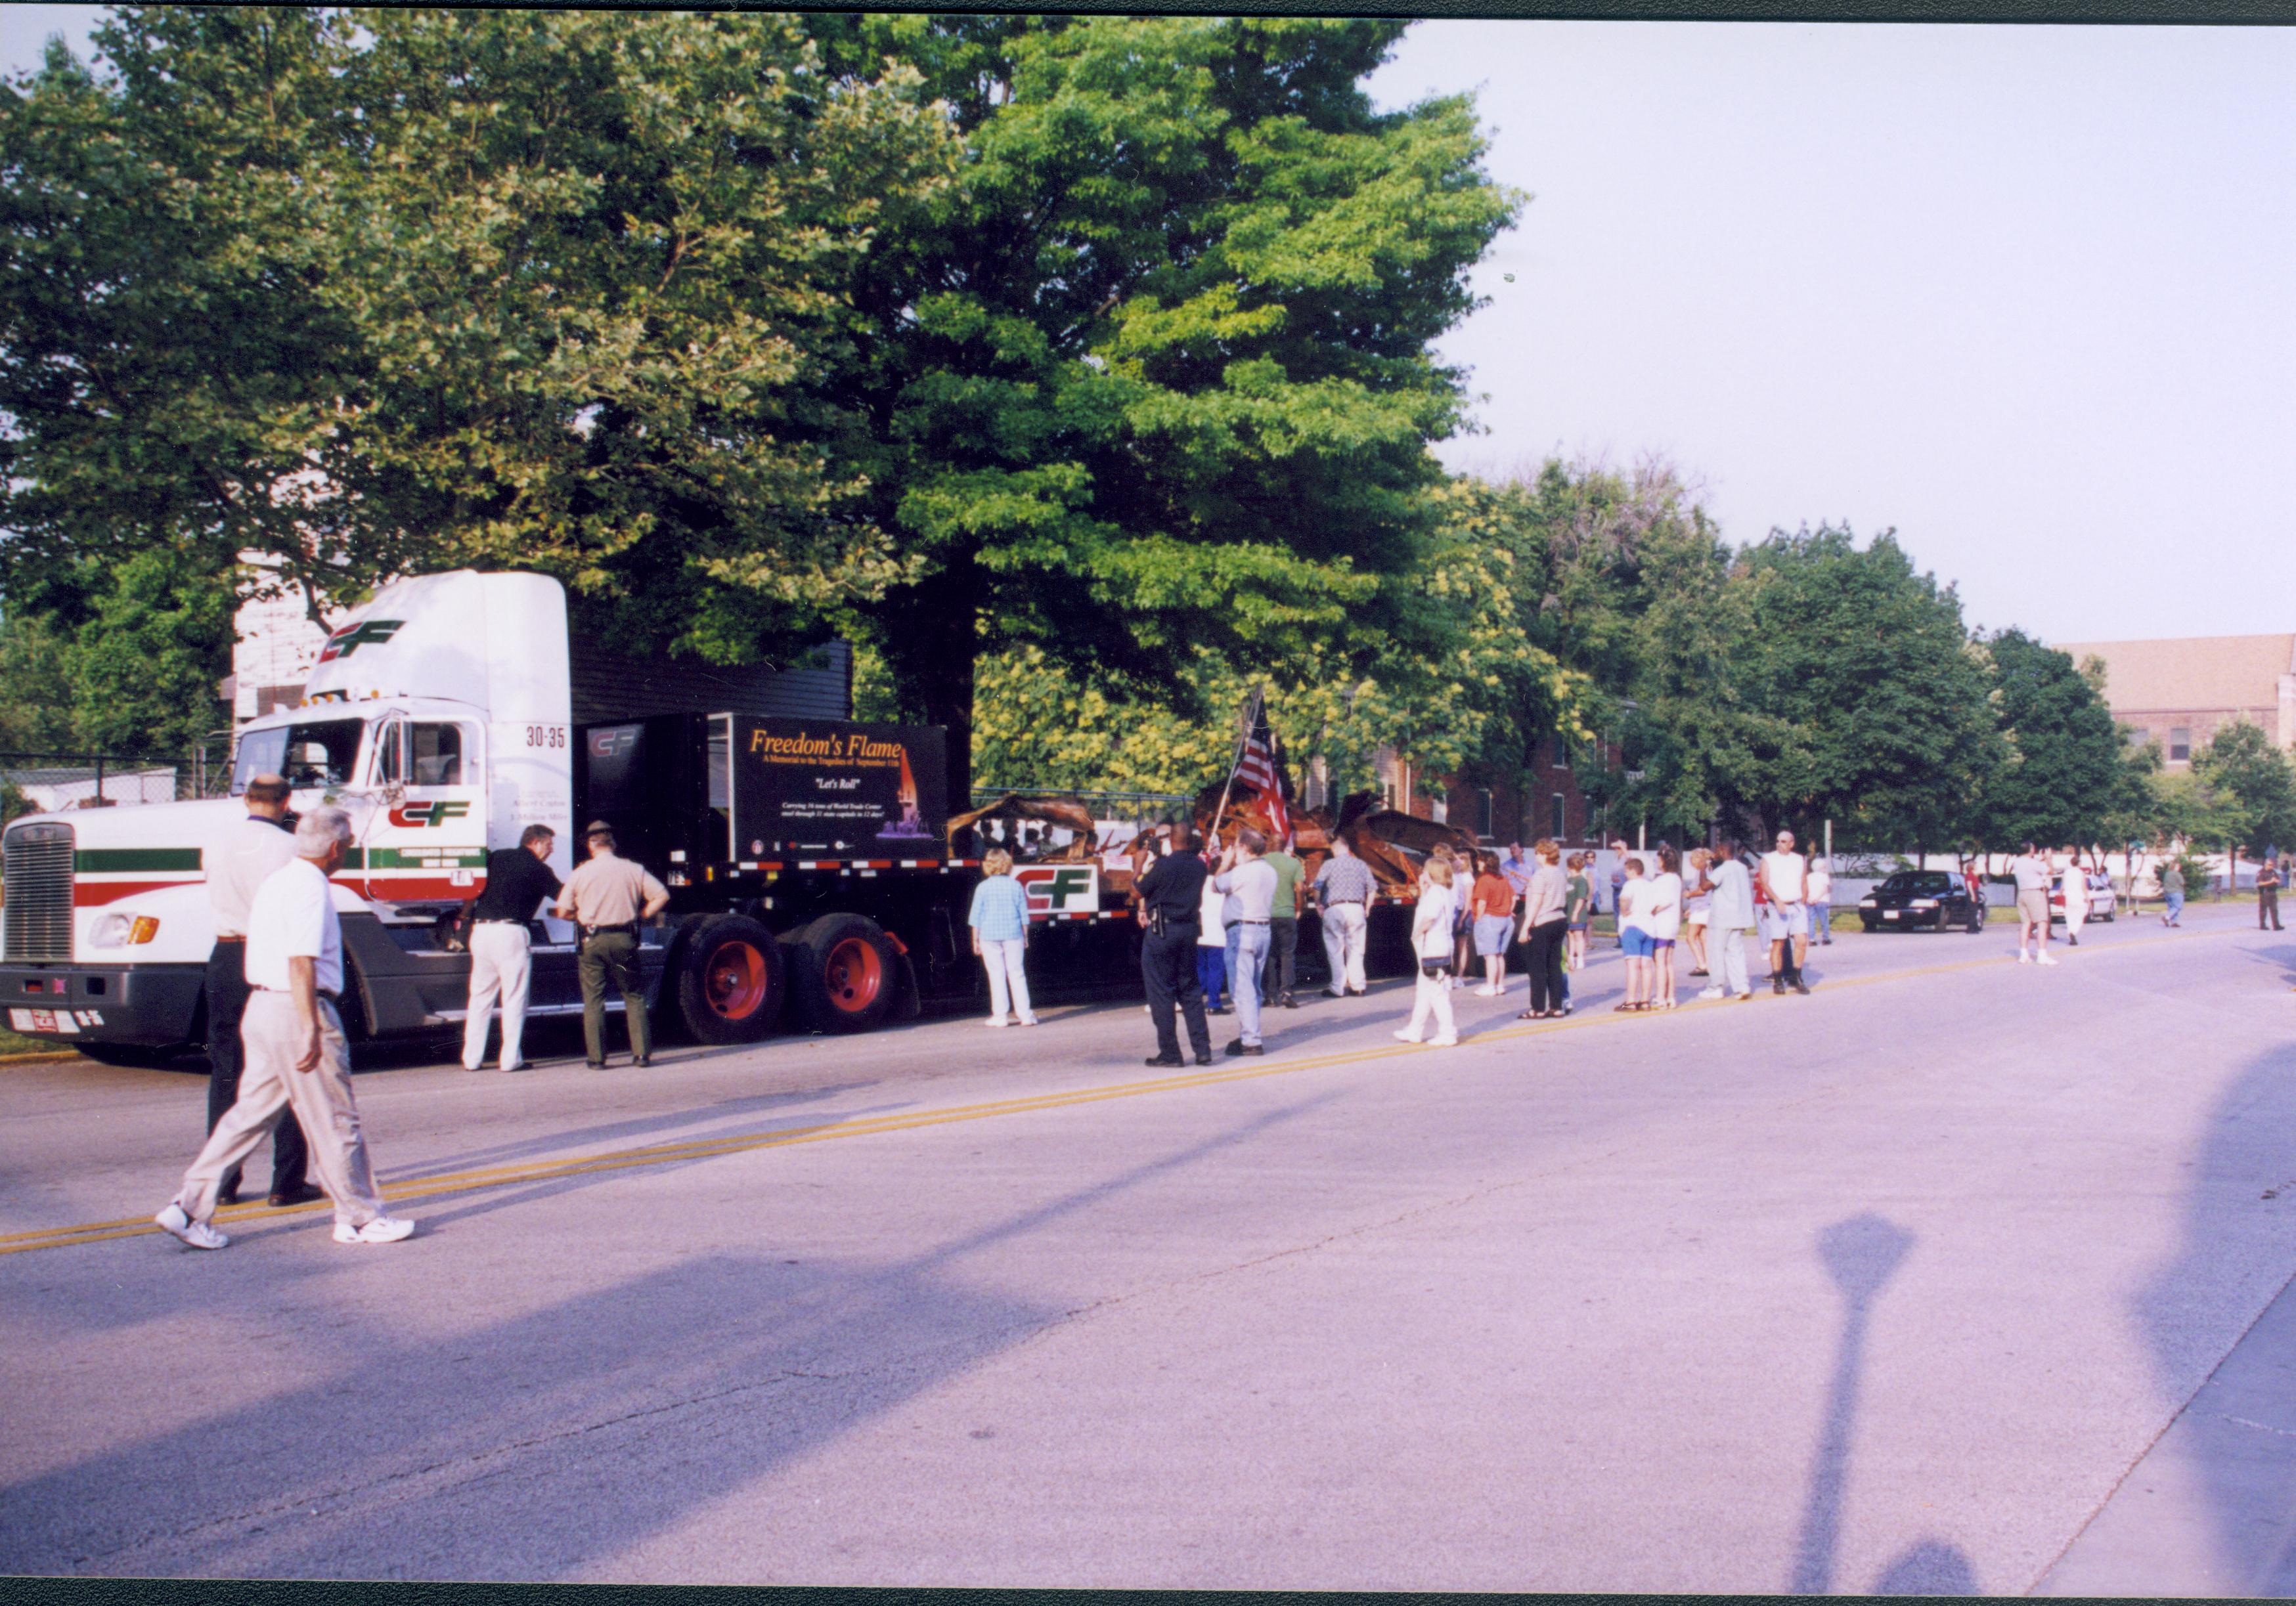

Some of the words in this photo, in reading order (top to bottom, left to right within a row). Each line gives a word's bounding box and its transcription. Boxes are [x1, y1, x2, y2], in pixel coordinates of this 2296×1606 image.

[527, 726, 564, 748] 30-35
[750, 729, 843, 756] Freedom's
[848, 735, 901, 758] Flame
[856, 758, 886, 768] September
[816, 778, 837, 789] "Let's
[839, 779, 860, 789] Roll"
[388, 801, 471, 827] CF
